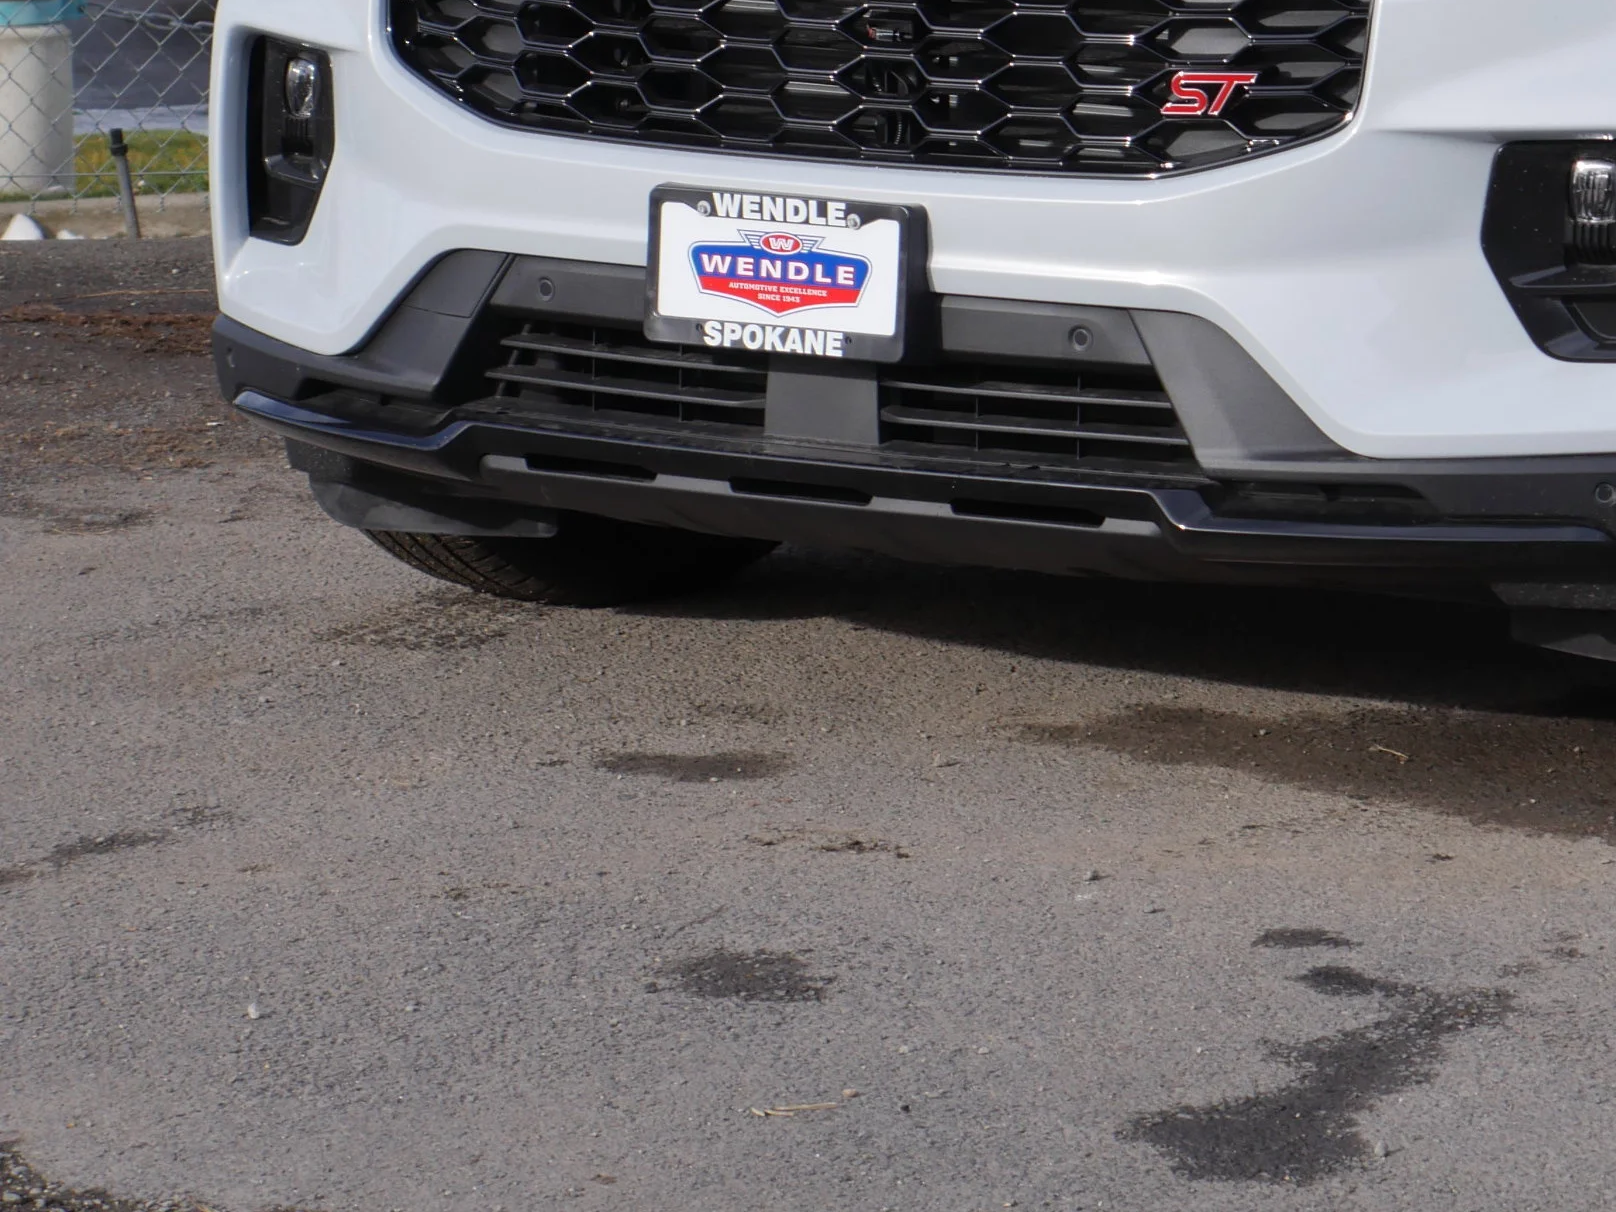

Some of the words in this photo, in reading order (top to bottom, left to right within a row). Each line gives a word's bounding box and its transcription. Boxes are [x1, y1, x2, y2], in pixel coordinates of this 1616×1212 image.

[1160, 71, 1258, 115] ST
[711, 192, 847, 227] WENDLE
[700, 253, 855, 286] WENDLE
[728, 281, 778, 293] AUTOMOTIVE
[779, 286, 828, 297] EXCELLENCE
[757, 292, 781, 301] SINCE
[782, 295, 801, 303] 1943
[703, 320, 844, 357] SPOKANE
